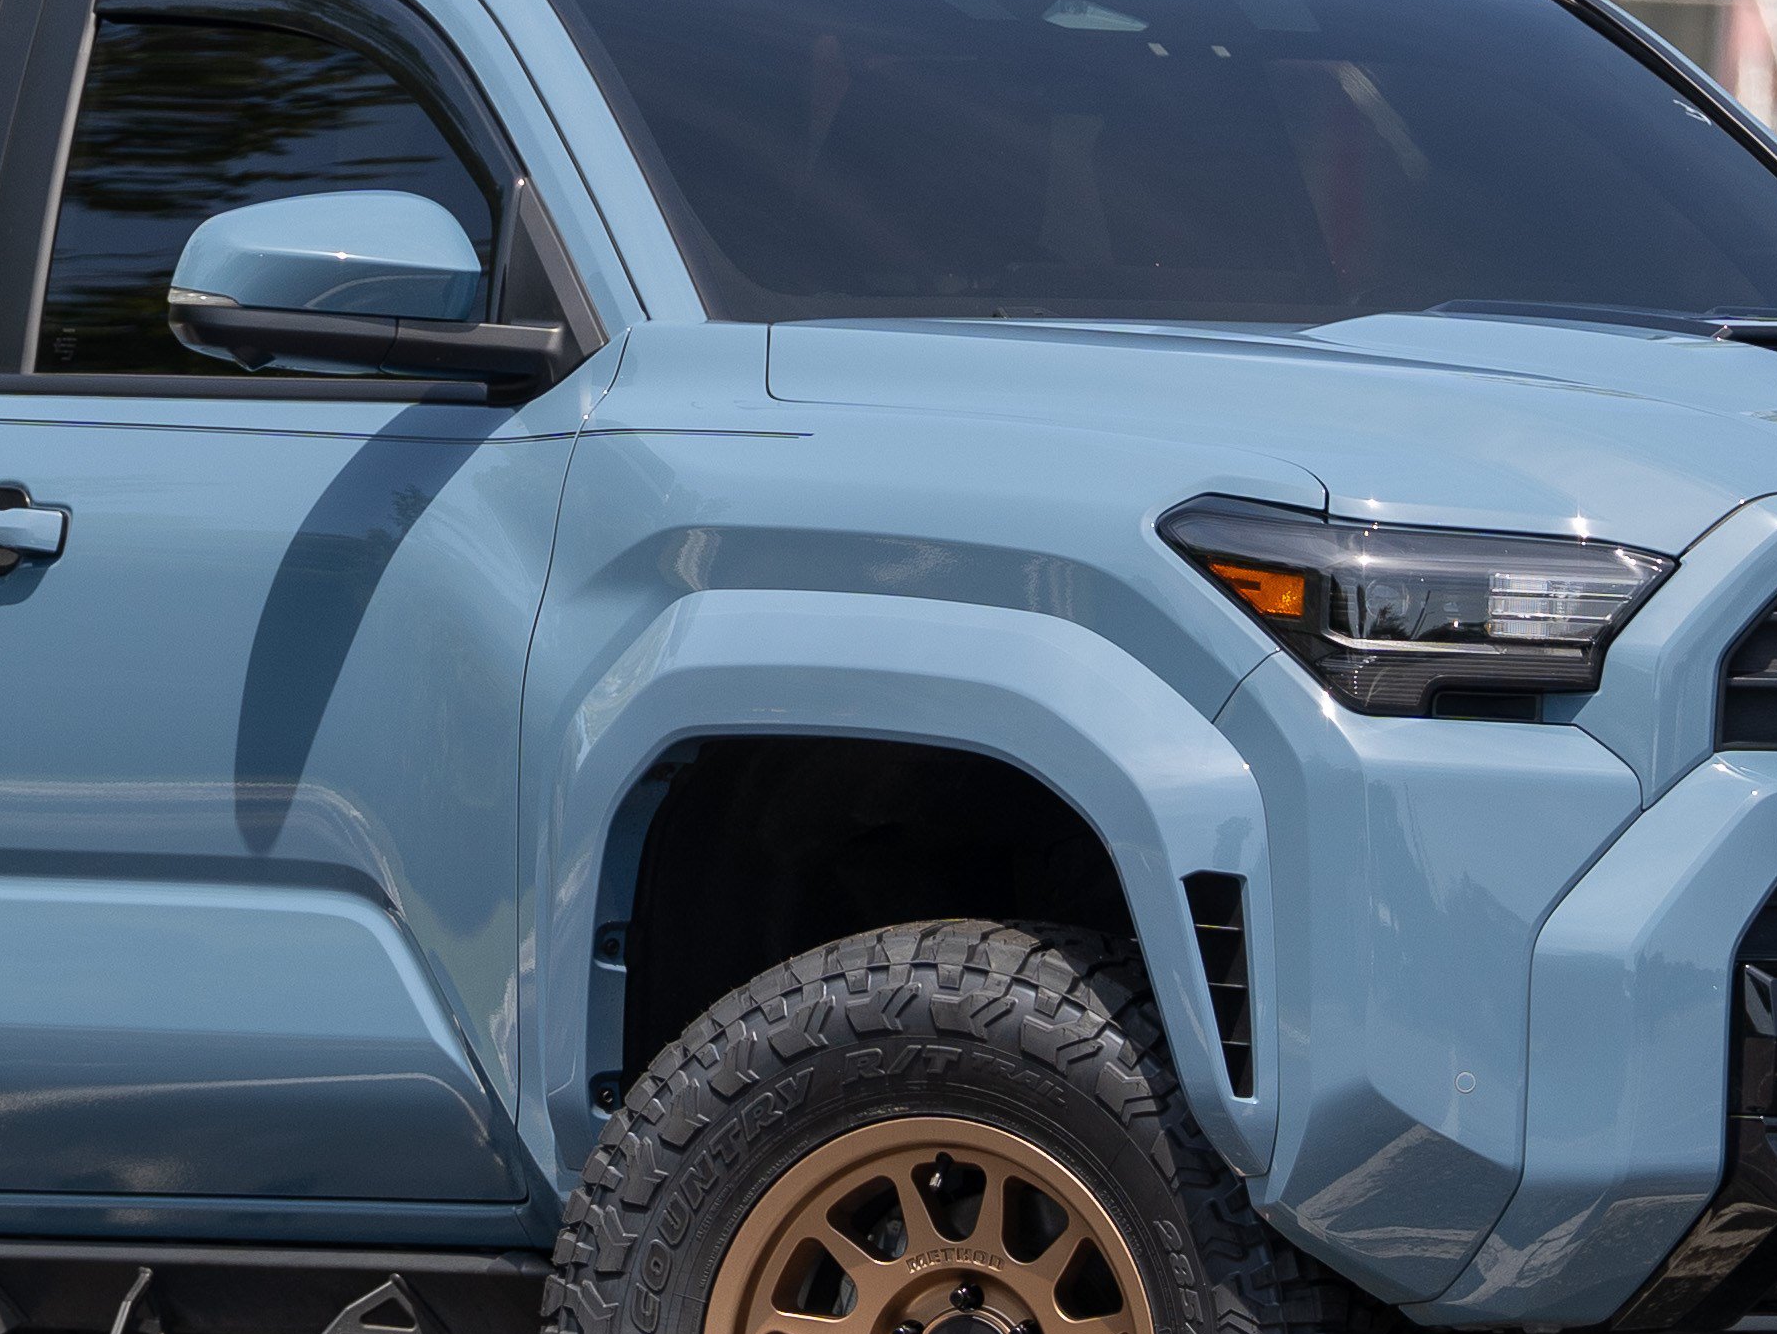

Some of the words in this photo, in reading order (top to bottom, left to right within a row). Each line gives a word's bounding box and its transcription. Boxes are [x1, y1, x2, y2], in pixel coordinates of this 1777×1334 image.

[630, 1067, 814, 1334] COUNTRY
[842, 1043, 963, 1085] R/T
[905, 1247, 1006, 1274] METHOD
